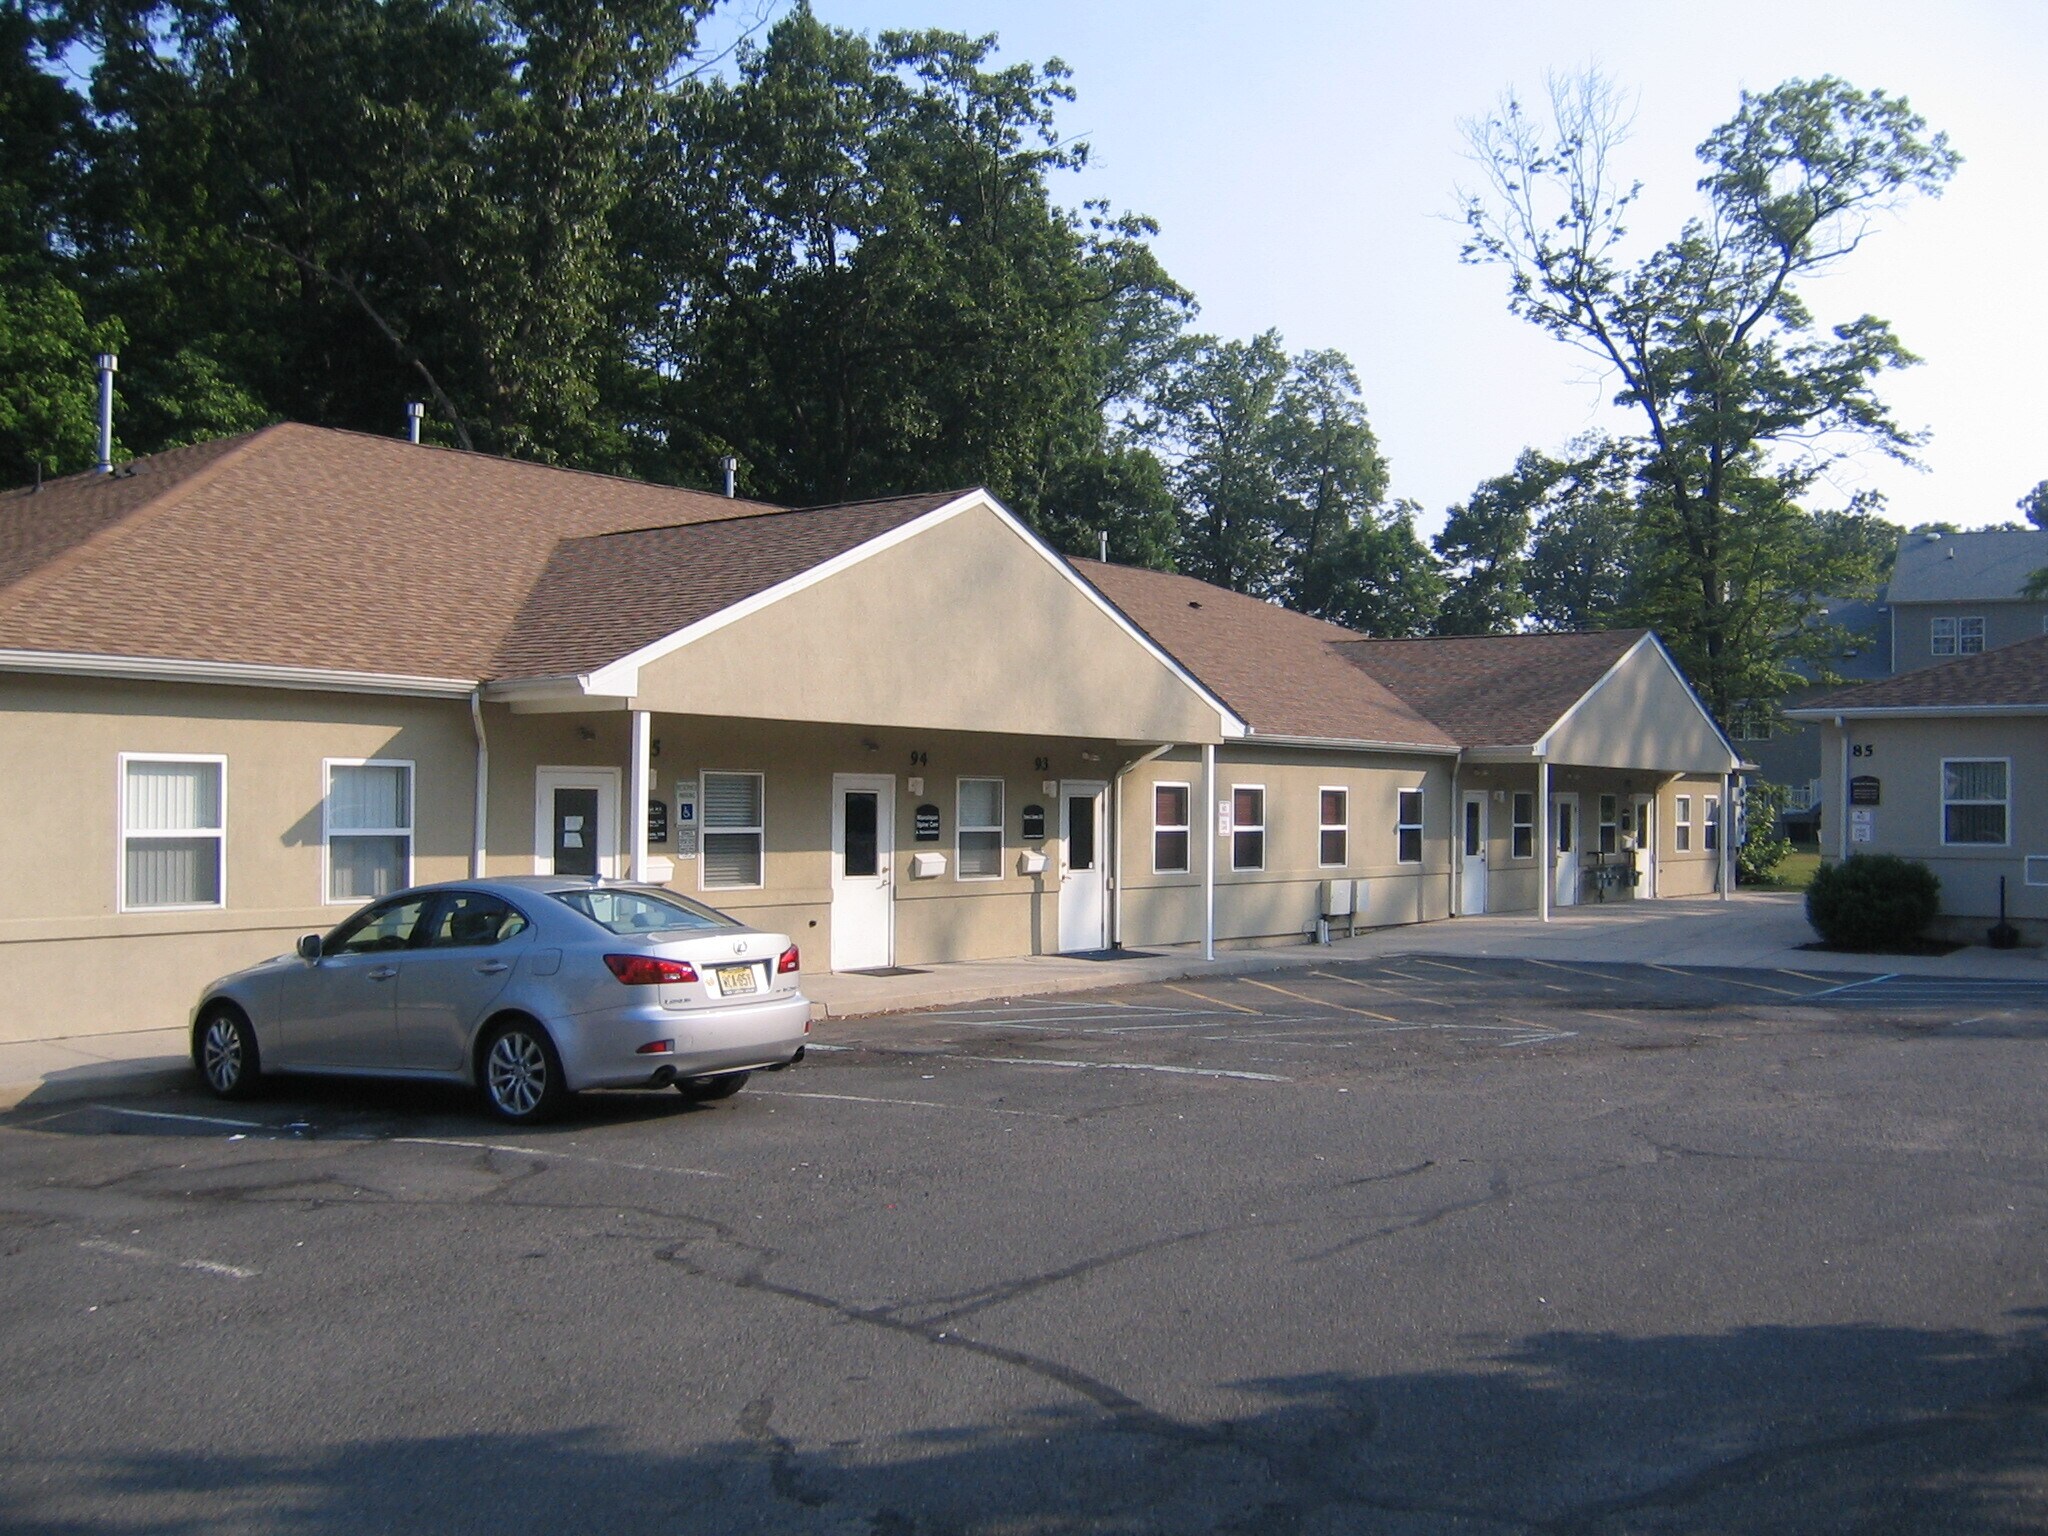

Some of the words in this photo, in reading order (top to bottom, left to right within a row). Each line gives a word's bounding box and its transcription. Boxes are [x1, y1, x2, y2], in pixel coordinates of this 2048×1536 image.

[1852, 744, 1874, 757] 85
[910, 751, 928, 767] 94
[1034, 757, 1049, 771] 93
